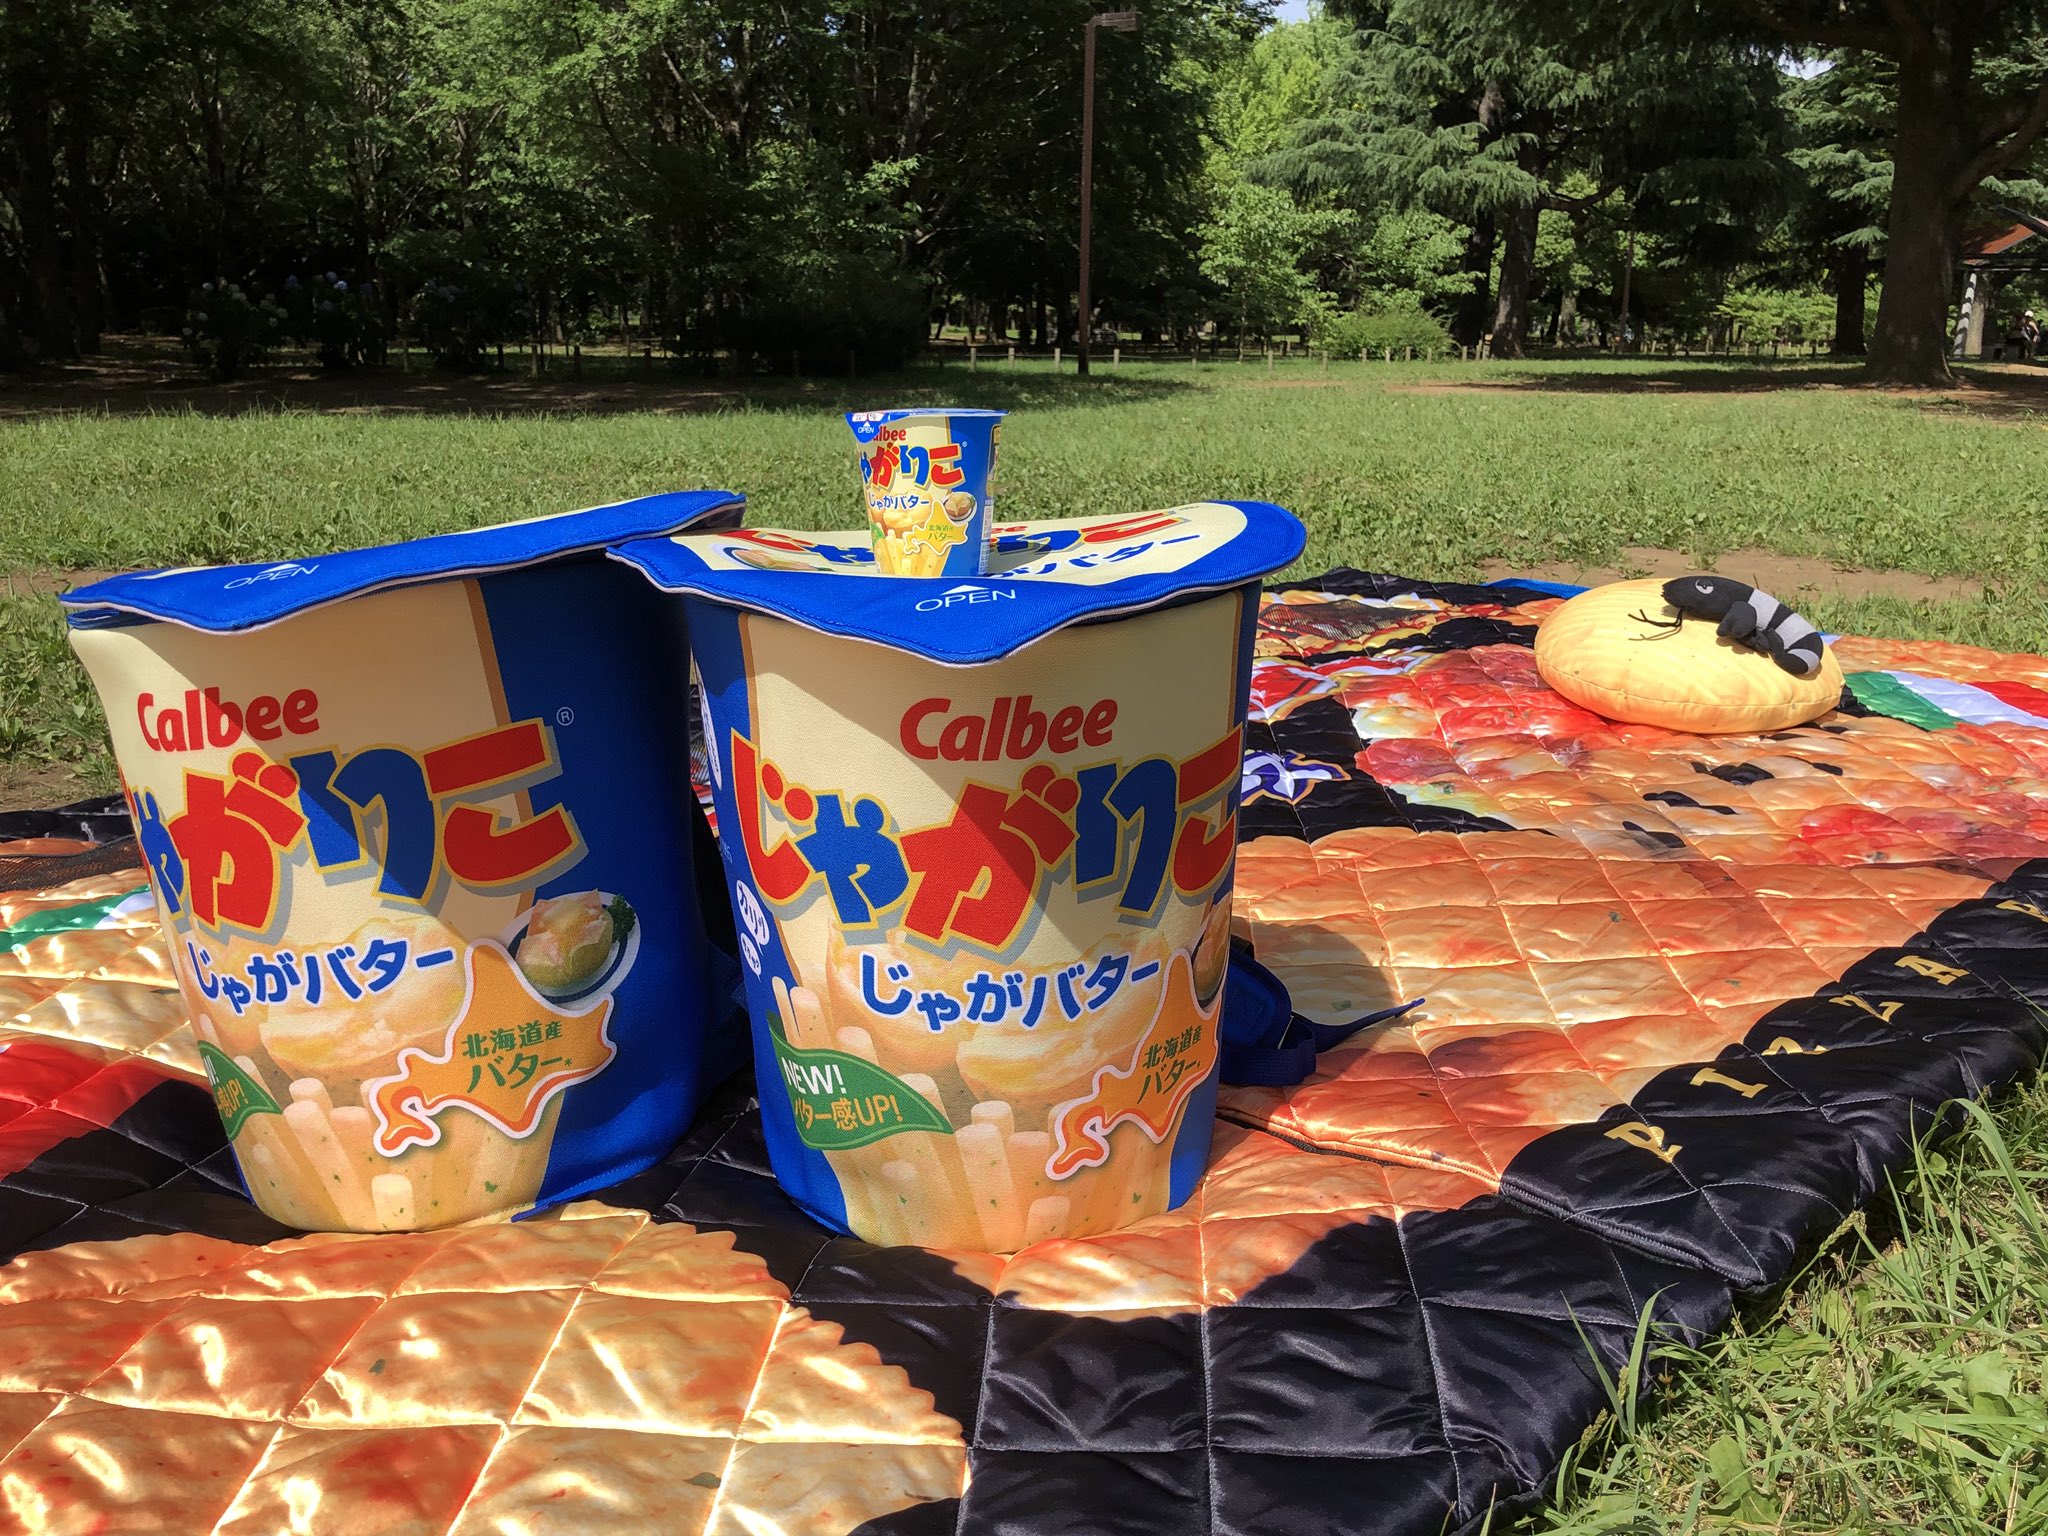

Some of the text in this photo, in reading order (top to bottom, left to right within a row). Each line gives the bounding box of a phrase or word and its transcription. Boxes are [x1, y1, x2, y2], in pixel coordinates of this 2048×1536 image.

[873, 425, 907, 442] lbee
[868, 494, 930, 511] じゃがバター
[224, 563, 319, 590] OPEN
[915, 588, 1016, 612] OPEN
[137, 686, 320, 752] Calbee
[900, 695, 1118, 762] Calbee
[120, 717, 585, 940] ゃがりこ
[731, 723, 1243, 953] じゃがりこ
[187, 939, 454, 1014] じゃがバター
[862, 953, 1160, 1032] じゃがバター
[461, 1020, 562, 1058] 北海道産
[1143, 1024, 1202, 1069] 北海道産
[781, 1057, 847, 1095] NEW!
